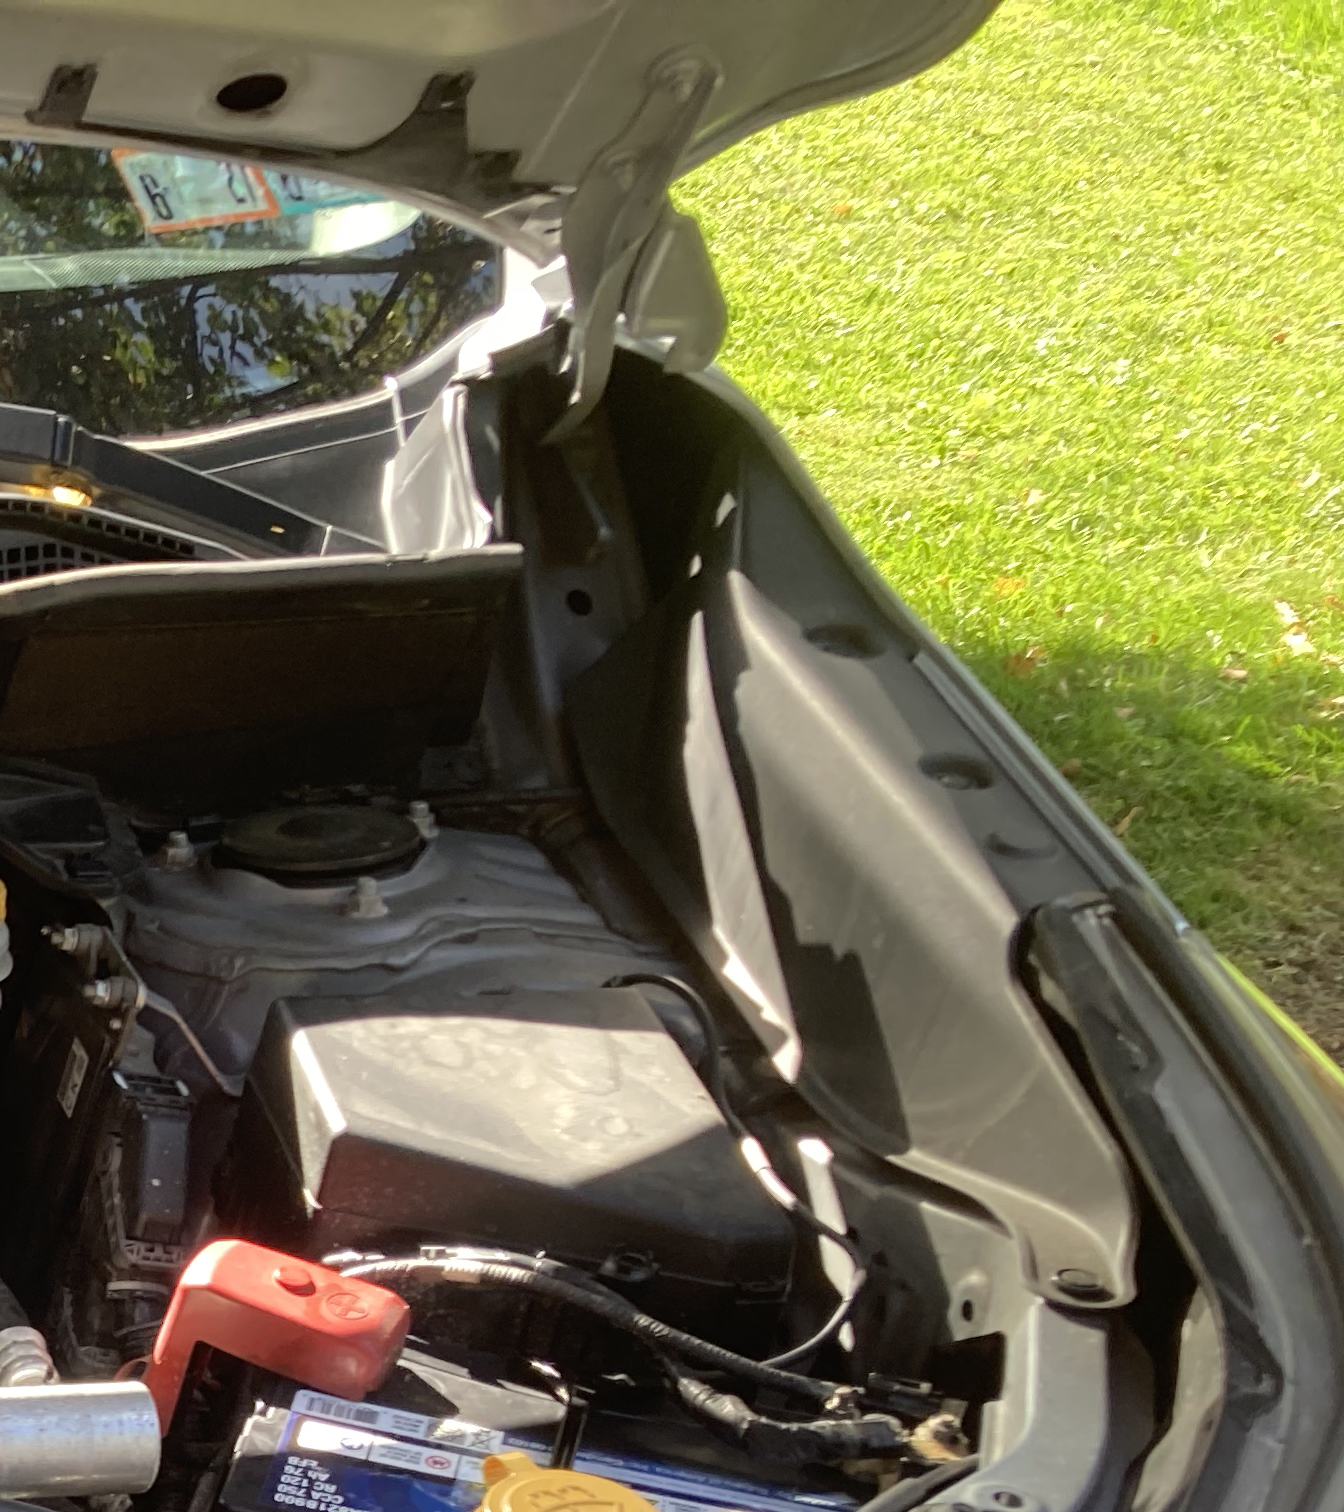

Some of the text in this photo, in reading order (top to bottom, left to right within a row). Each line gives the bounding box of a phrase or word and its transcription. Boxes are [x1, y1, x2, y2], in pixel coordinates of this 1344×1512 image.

[280, 1474, 338, 1493] RC 120
[276, 1483, 345, 1505] CCA 750
